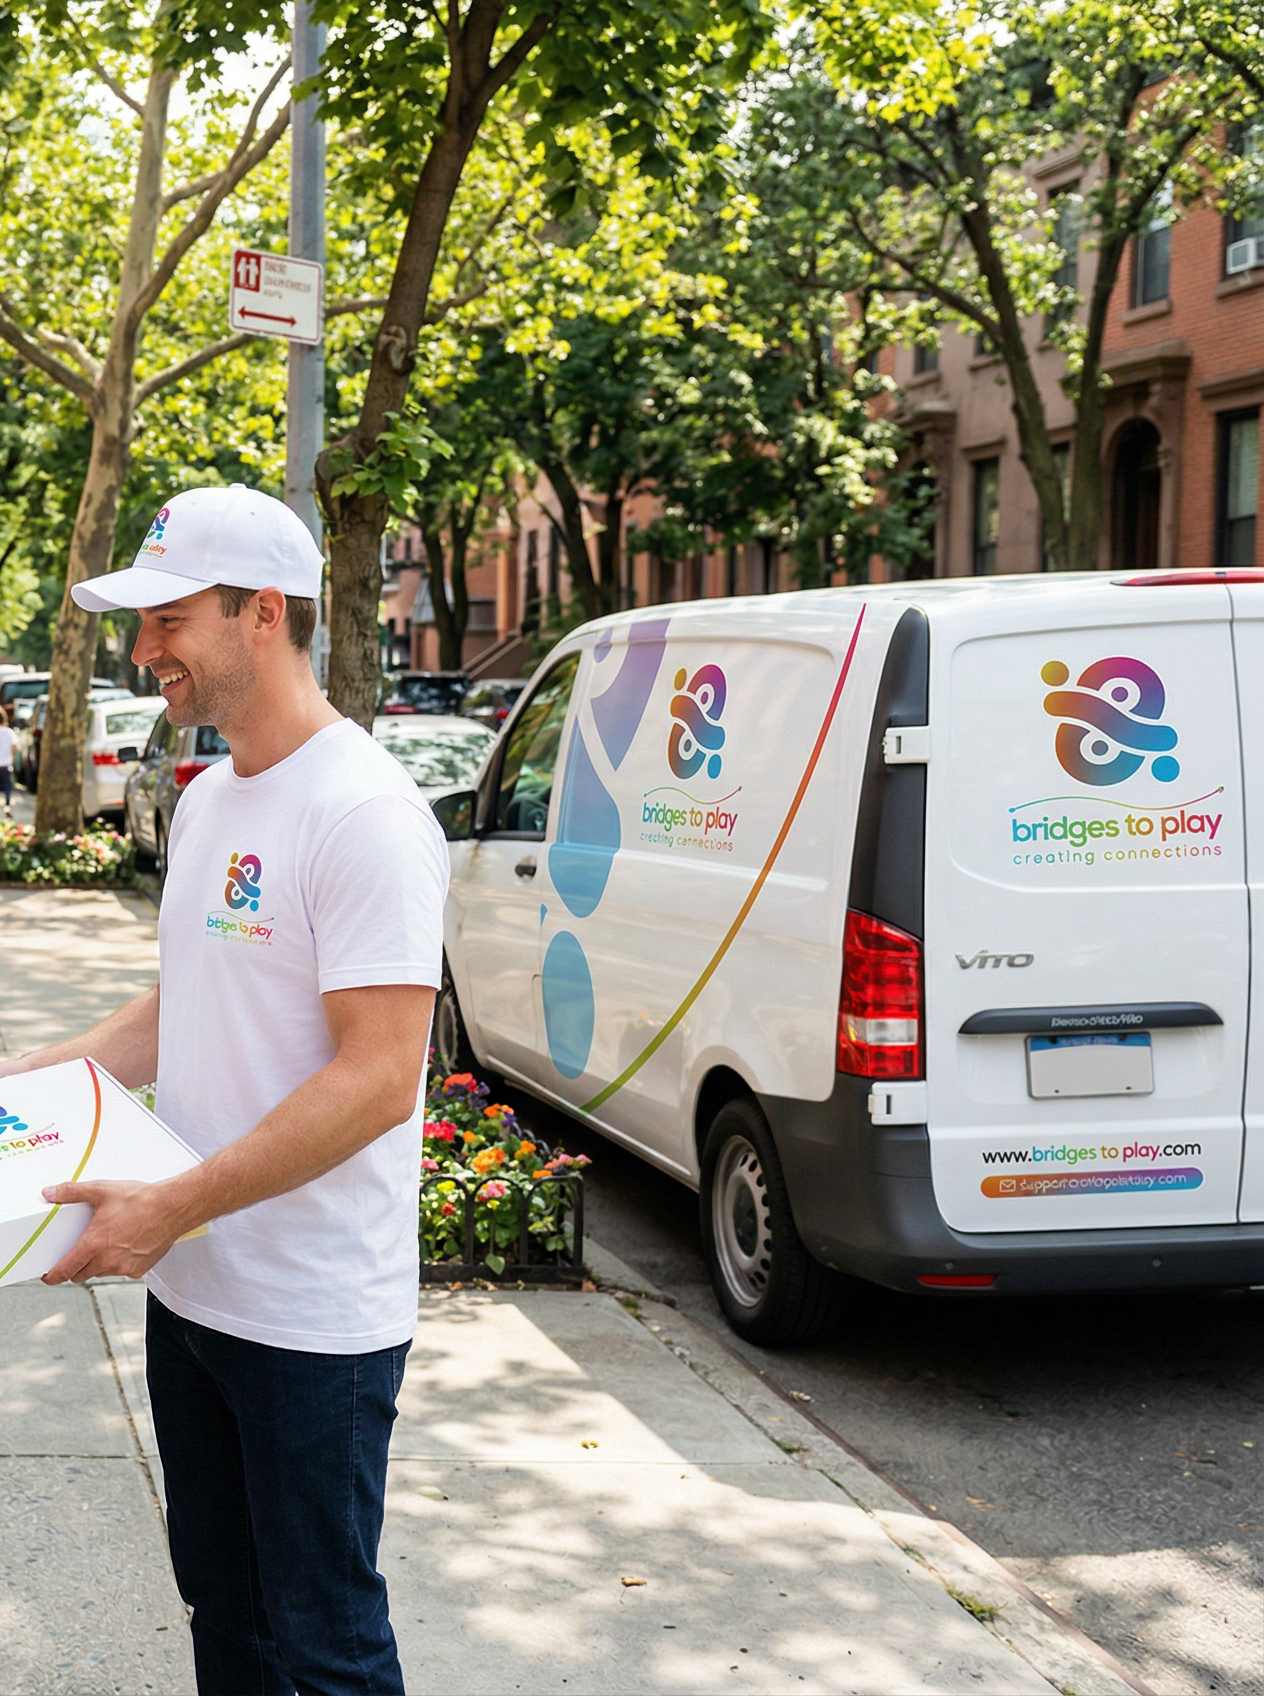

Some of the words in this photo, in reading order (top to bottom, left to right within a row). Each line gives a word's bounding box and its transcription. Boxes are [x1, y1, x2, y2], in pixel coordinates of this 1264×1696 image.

[642, 802, 687, 832] bridges
[689, 806, 703, 828] to
[704, 806, 738, 837] play
[1011, 815, 1120, 848] bridges
[1125, 813, 1154, 836] to
[1161, 810, 1223, 842] play
[1013, 849, 1095, 866] creating
[1103, 844, 1222, 861] connections
[1100, 1145, 1119, 1159] to
[1122, 1141, 1202, 1163] play.com
